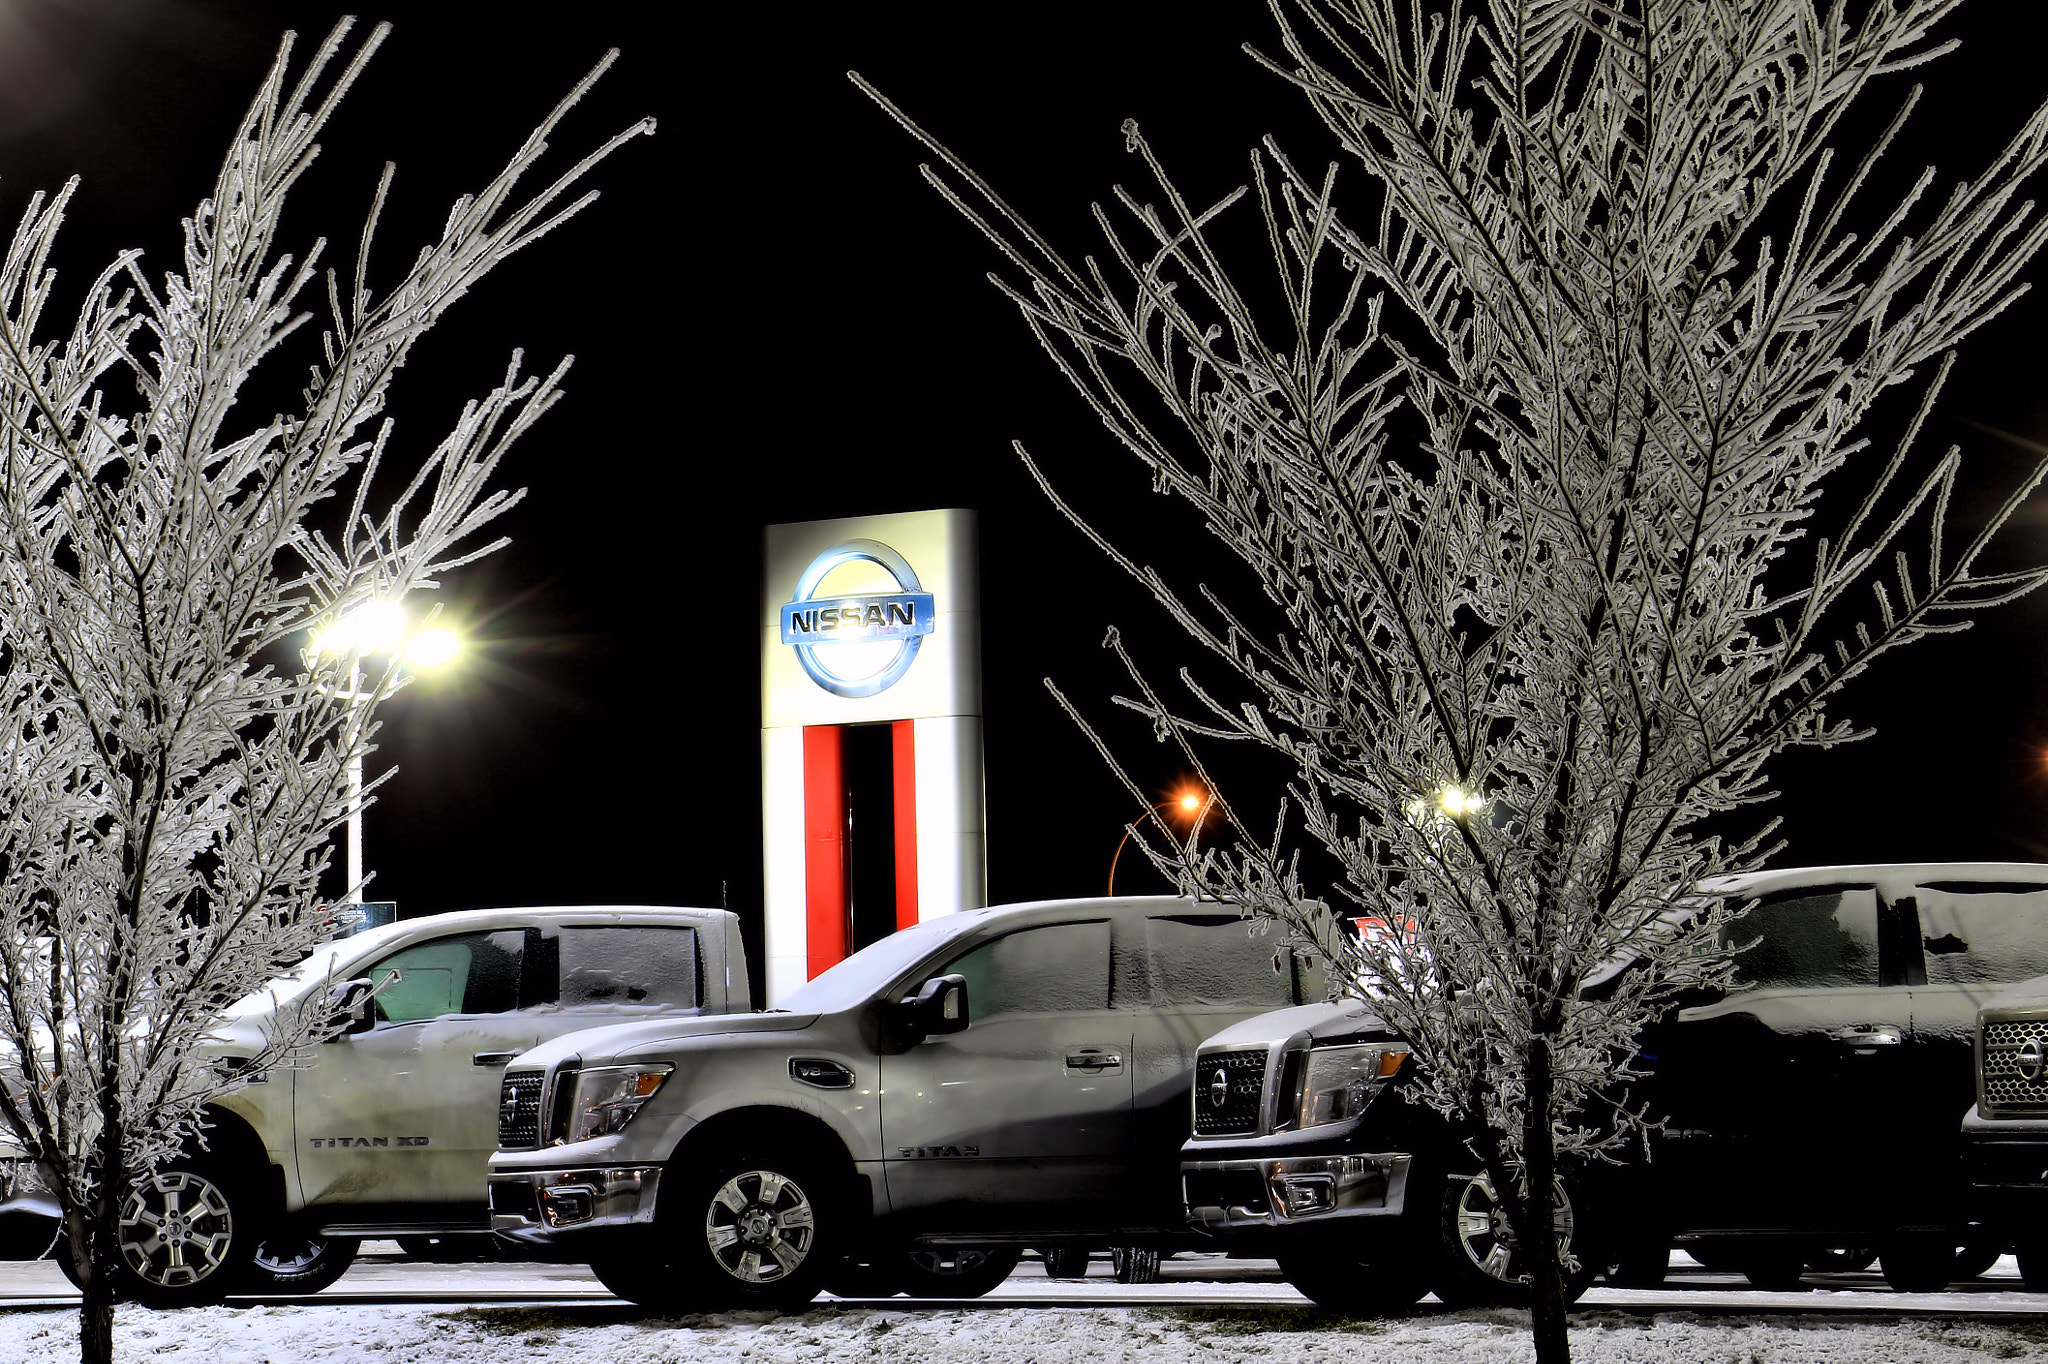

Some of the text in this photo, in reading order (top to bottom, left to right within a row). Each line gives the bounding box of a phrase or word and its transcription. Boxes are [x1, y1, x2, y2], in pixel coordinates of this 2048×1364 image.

[791, 602, 915, 634] NISSAN
[310, 1136, 430, 1148] TITAN XD
[898, 1145, 980, 1158] TITAN
